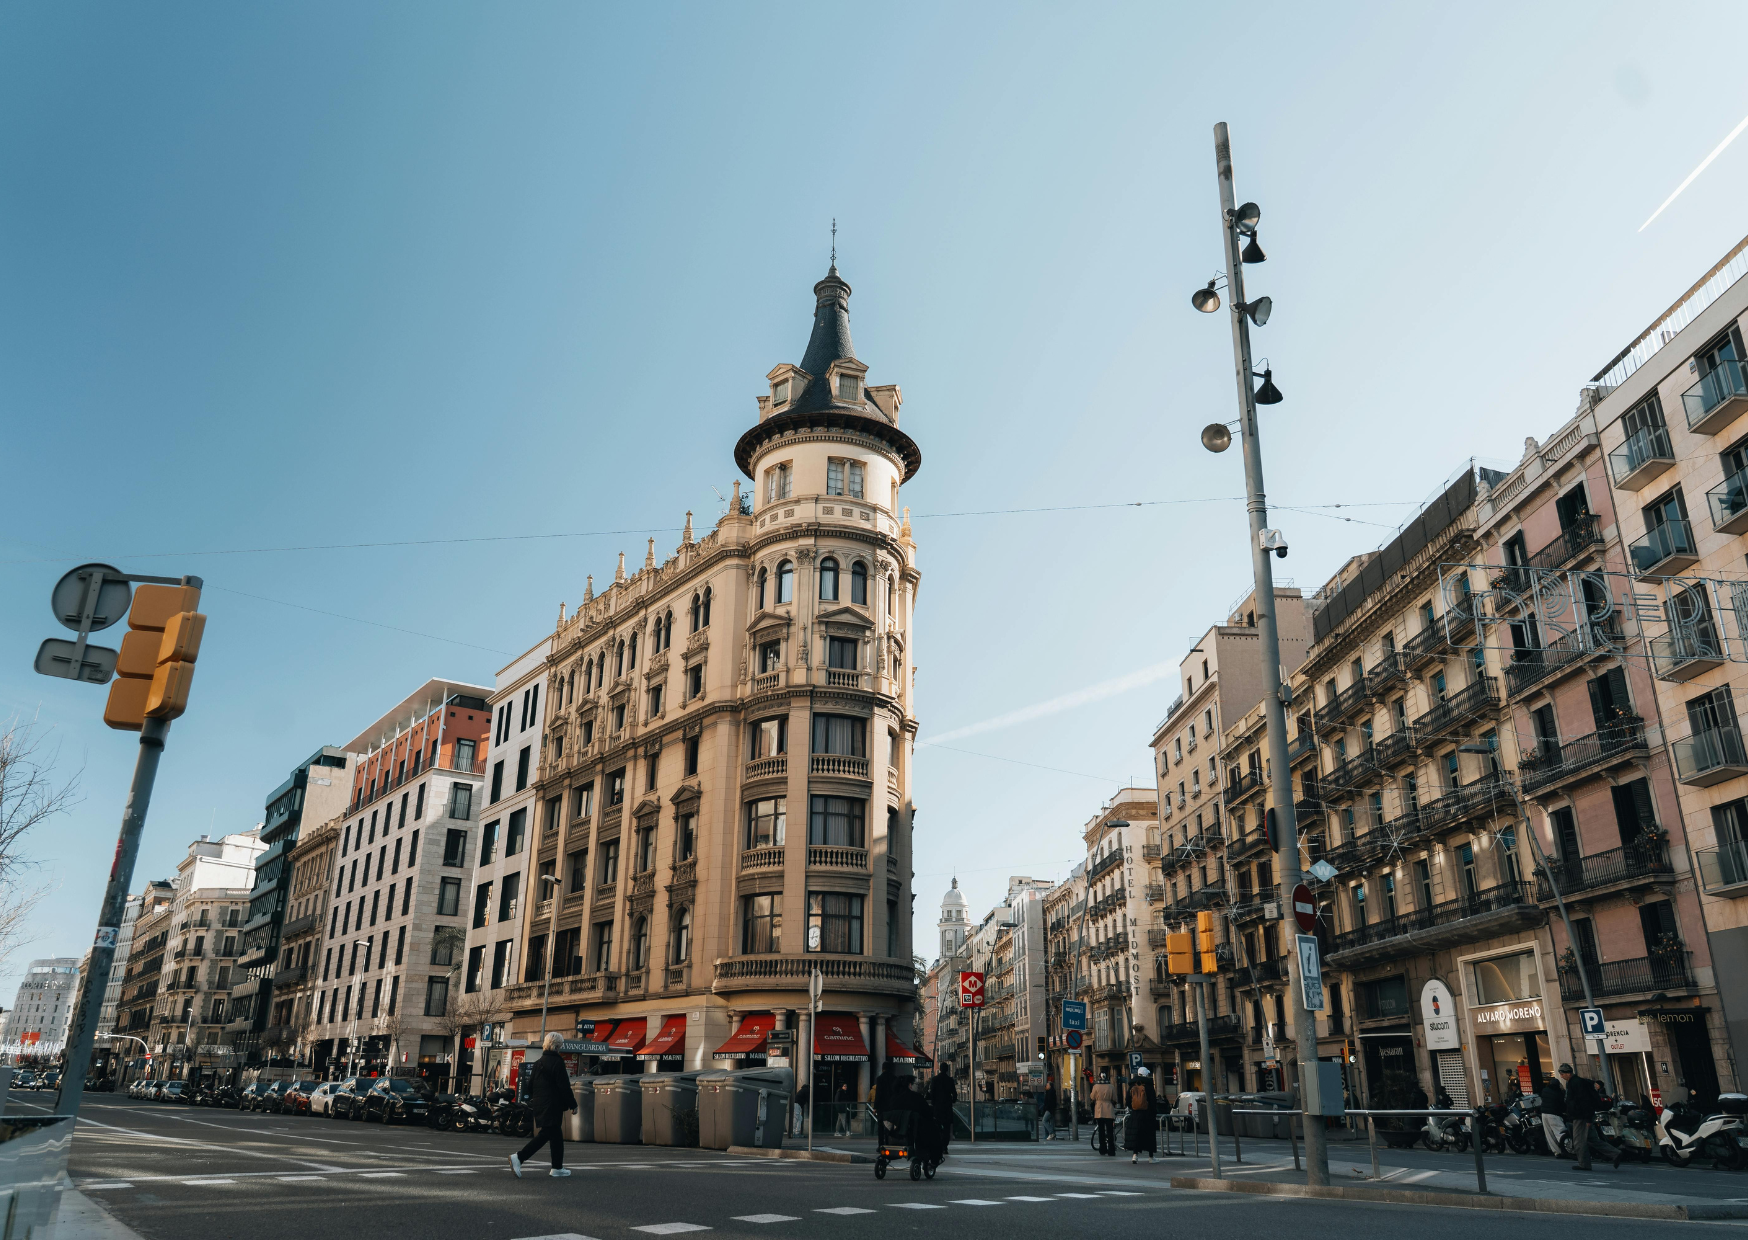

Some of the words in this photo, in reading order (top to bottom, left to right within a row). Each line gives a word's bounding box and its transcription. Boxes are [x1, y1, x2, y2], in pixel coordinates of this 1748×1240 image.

[1124, 844, 1136, 899] HOTEL
[1129, 917, 1141, 996] MIDMOST
[968, 979, 978, 989] M
[1477, 1011, 1505, 1023] ALVARO
[1507, 1006, 1542, 1020] MORENO
[1584, 1012, 1599, 1032] P
[1657, 1013, 1695, 1023] lemon
[484, 1025, 490, 1040] P
[566, 1043, 607, 1051] VANGUARDIA
[1131, 1054, 1141, 1066] P
